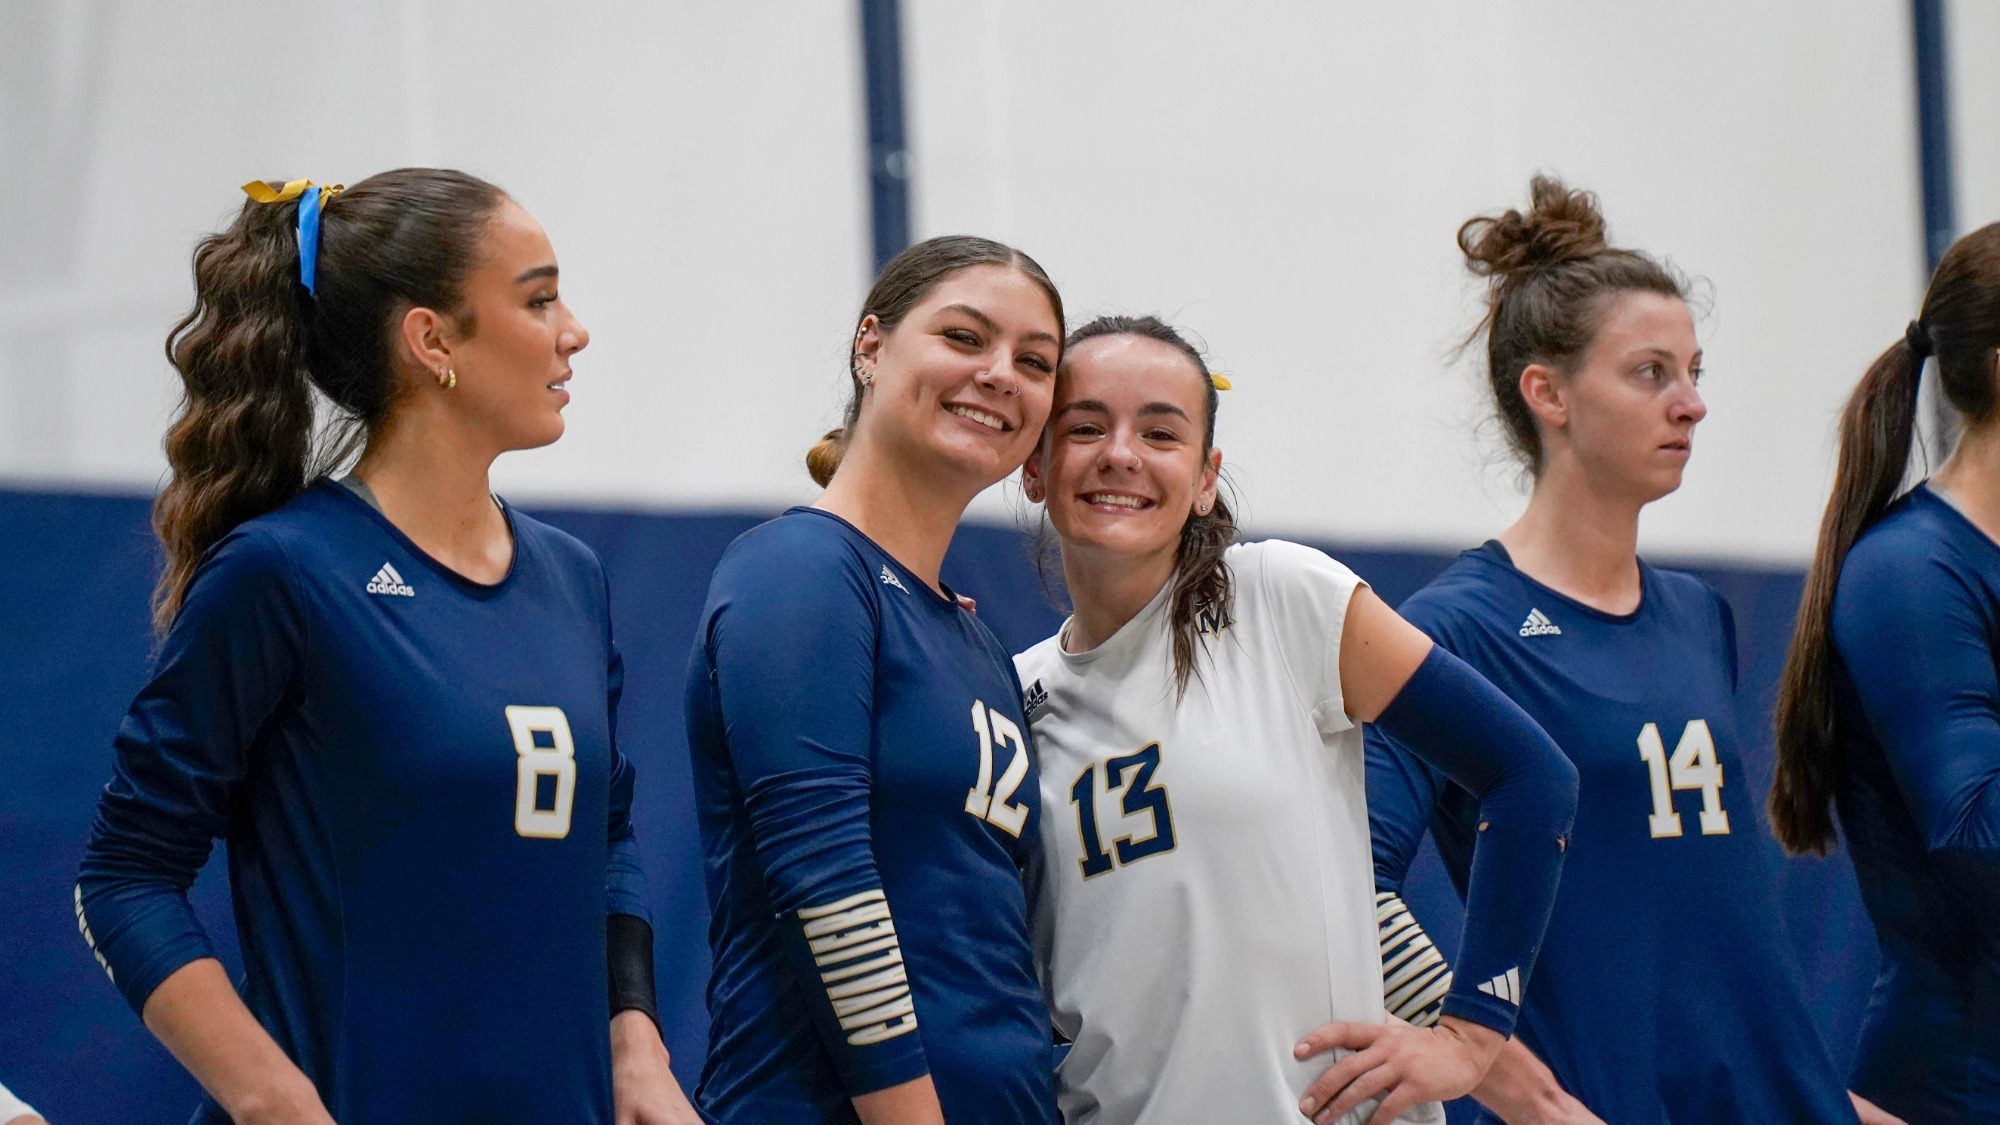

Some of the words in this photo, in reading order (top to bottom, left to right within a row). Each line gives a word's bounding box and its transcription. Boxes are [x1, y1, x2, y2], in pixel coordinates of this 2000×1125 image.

[366, 582, 415, 597] adidas
[1519, 624, 1562, 637] adidas
[505, 705, 576, 839] 8
[965, 699, 1029, 838] 12
[1069, 740, 1178, 881] 13
[1636, 719, 1730, 839] 14
[797, 889, 918, 1046] CAVALIERS
